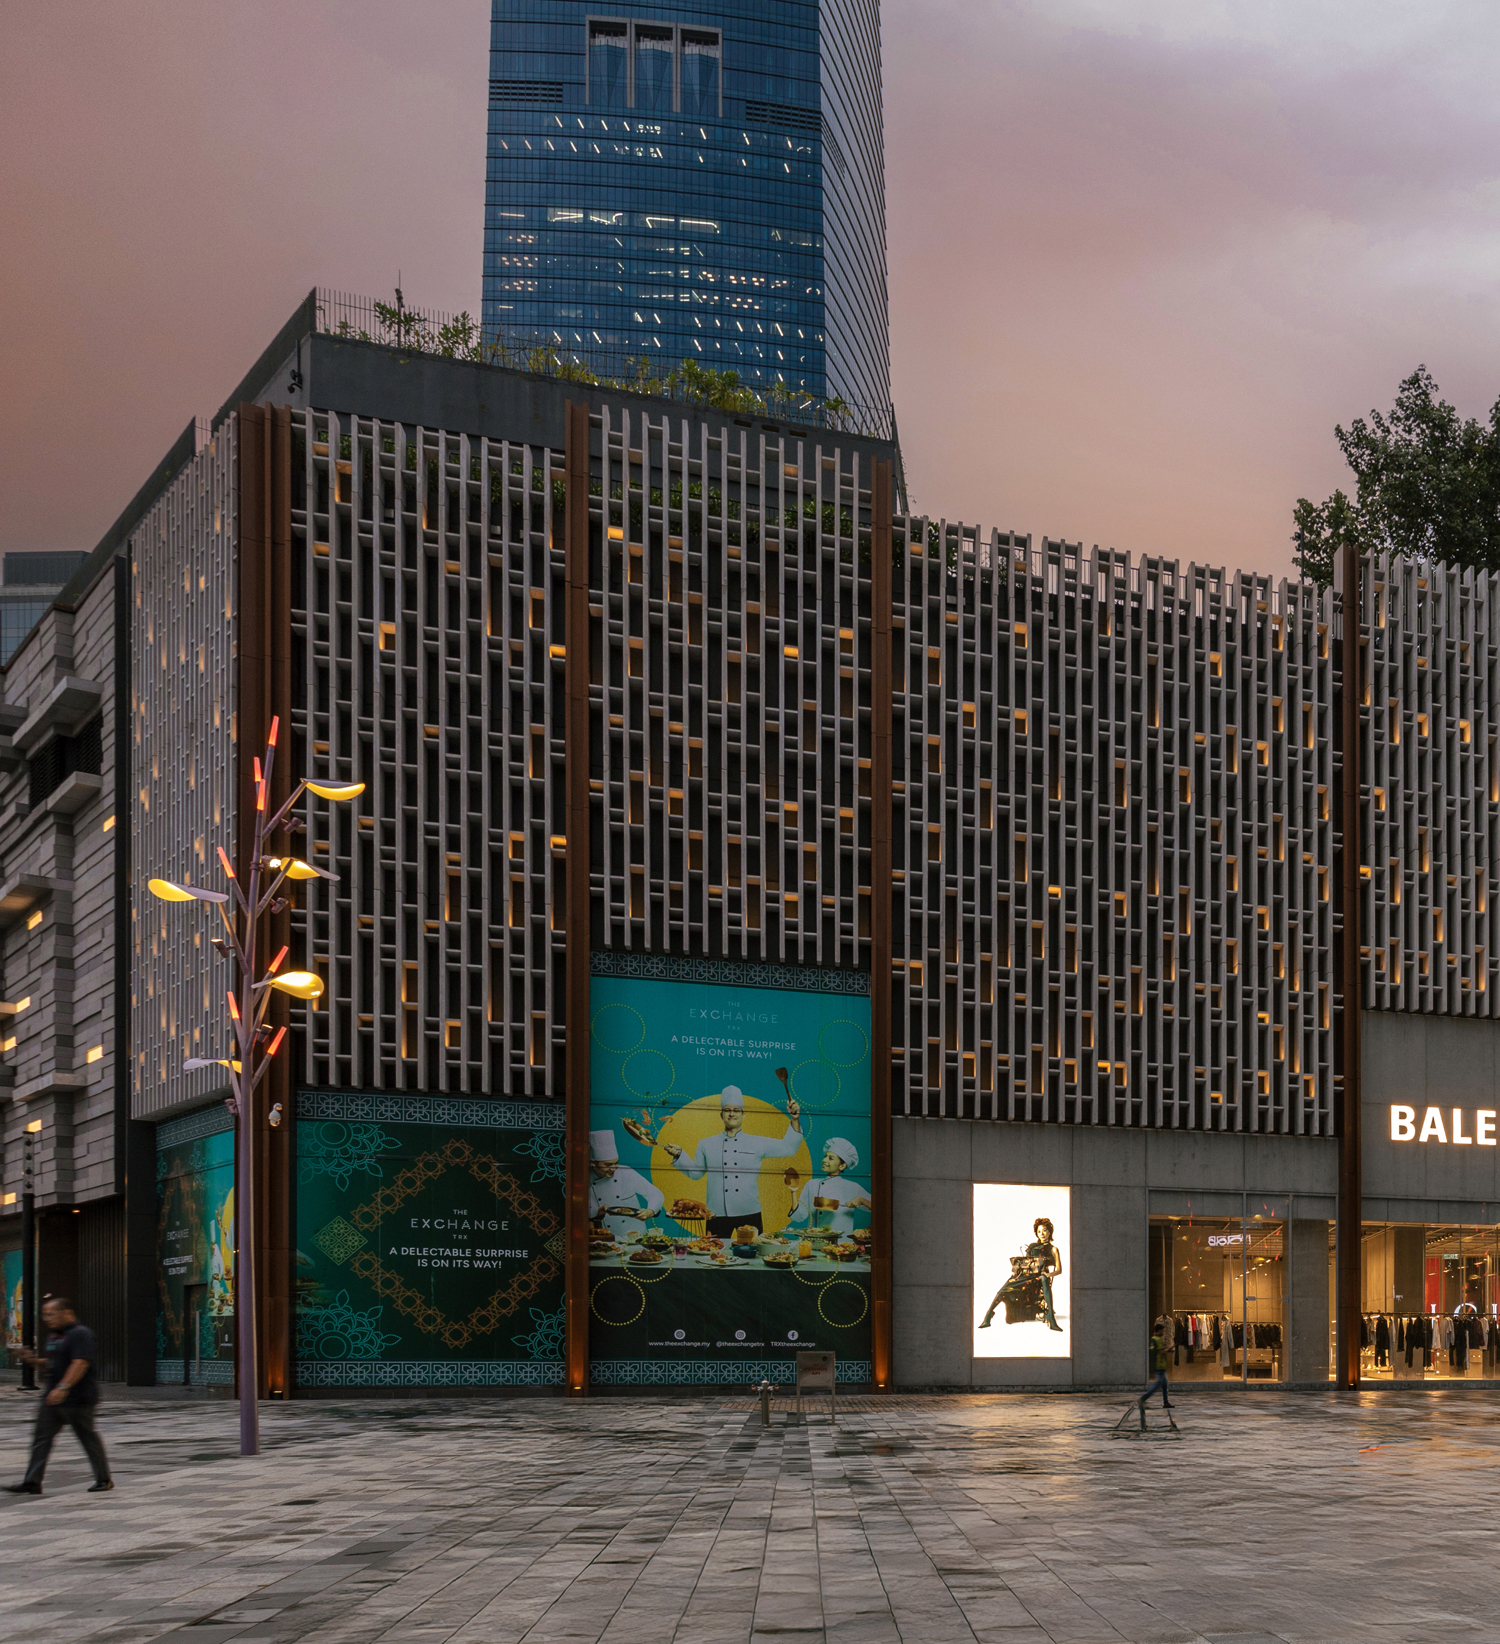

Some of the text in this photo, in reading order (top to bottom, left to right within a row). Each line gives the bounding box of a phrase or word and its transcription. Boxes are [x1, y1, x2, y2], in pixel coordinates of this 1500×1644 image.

[689, 1008, 778, 1023] EXCHANGE
[671, 1035, 796, 1051] A DELECTABLE SURPRISE
[696, 1047, 772, 1060] IS ON ITS WAY!
[410, 1218, 509, 1231] EXCHANGE
[389, 1247, 529, 1258] A DELECTABLE SURPRISE
[417, 1259, 502, 1269] IS ON ITS WAY!
